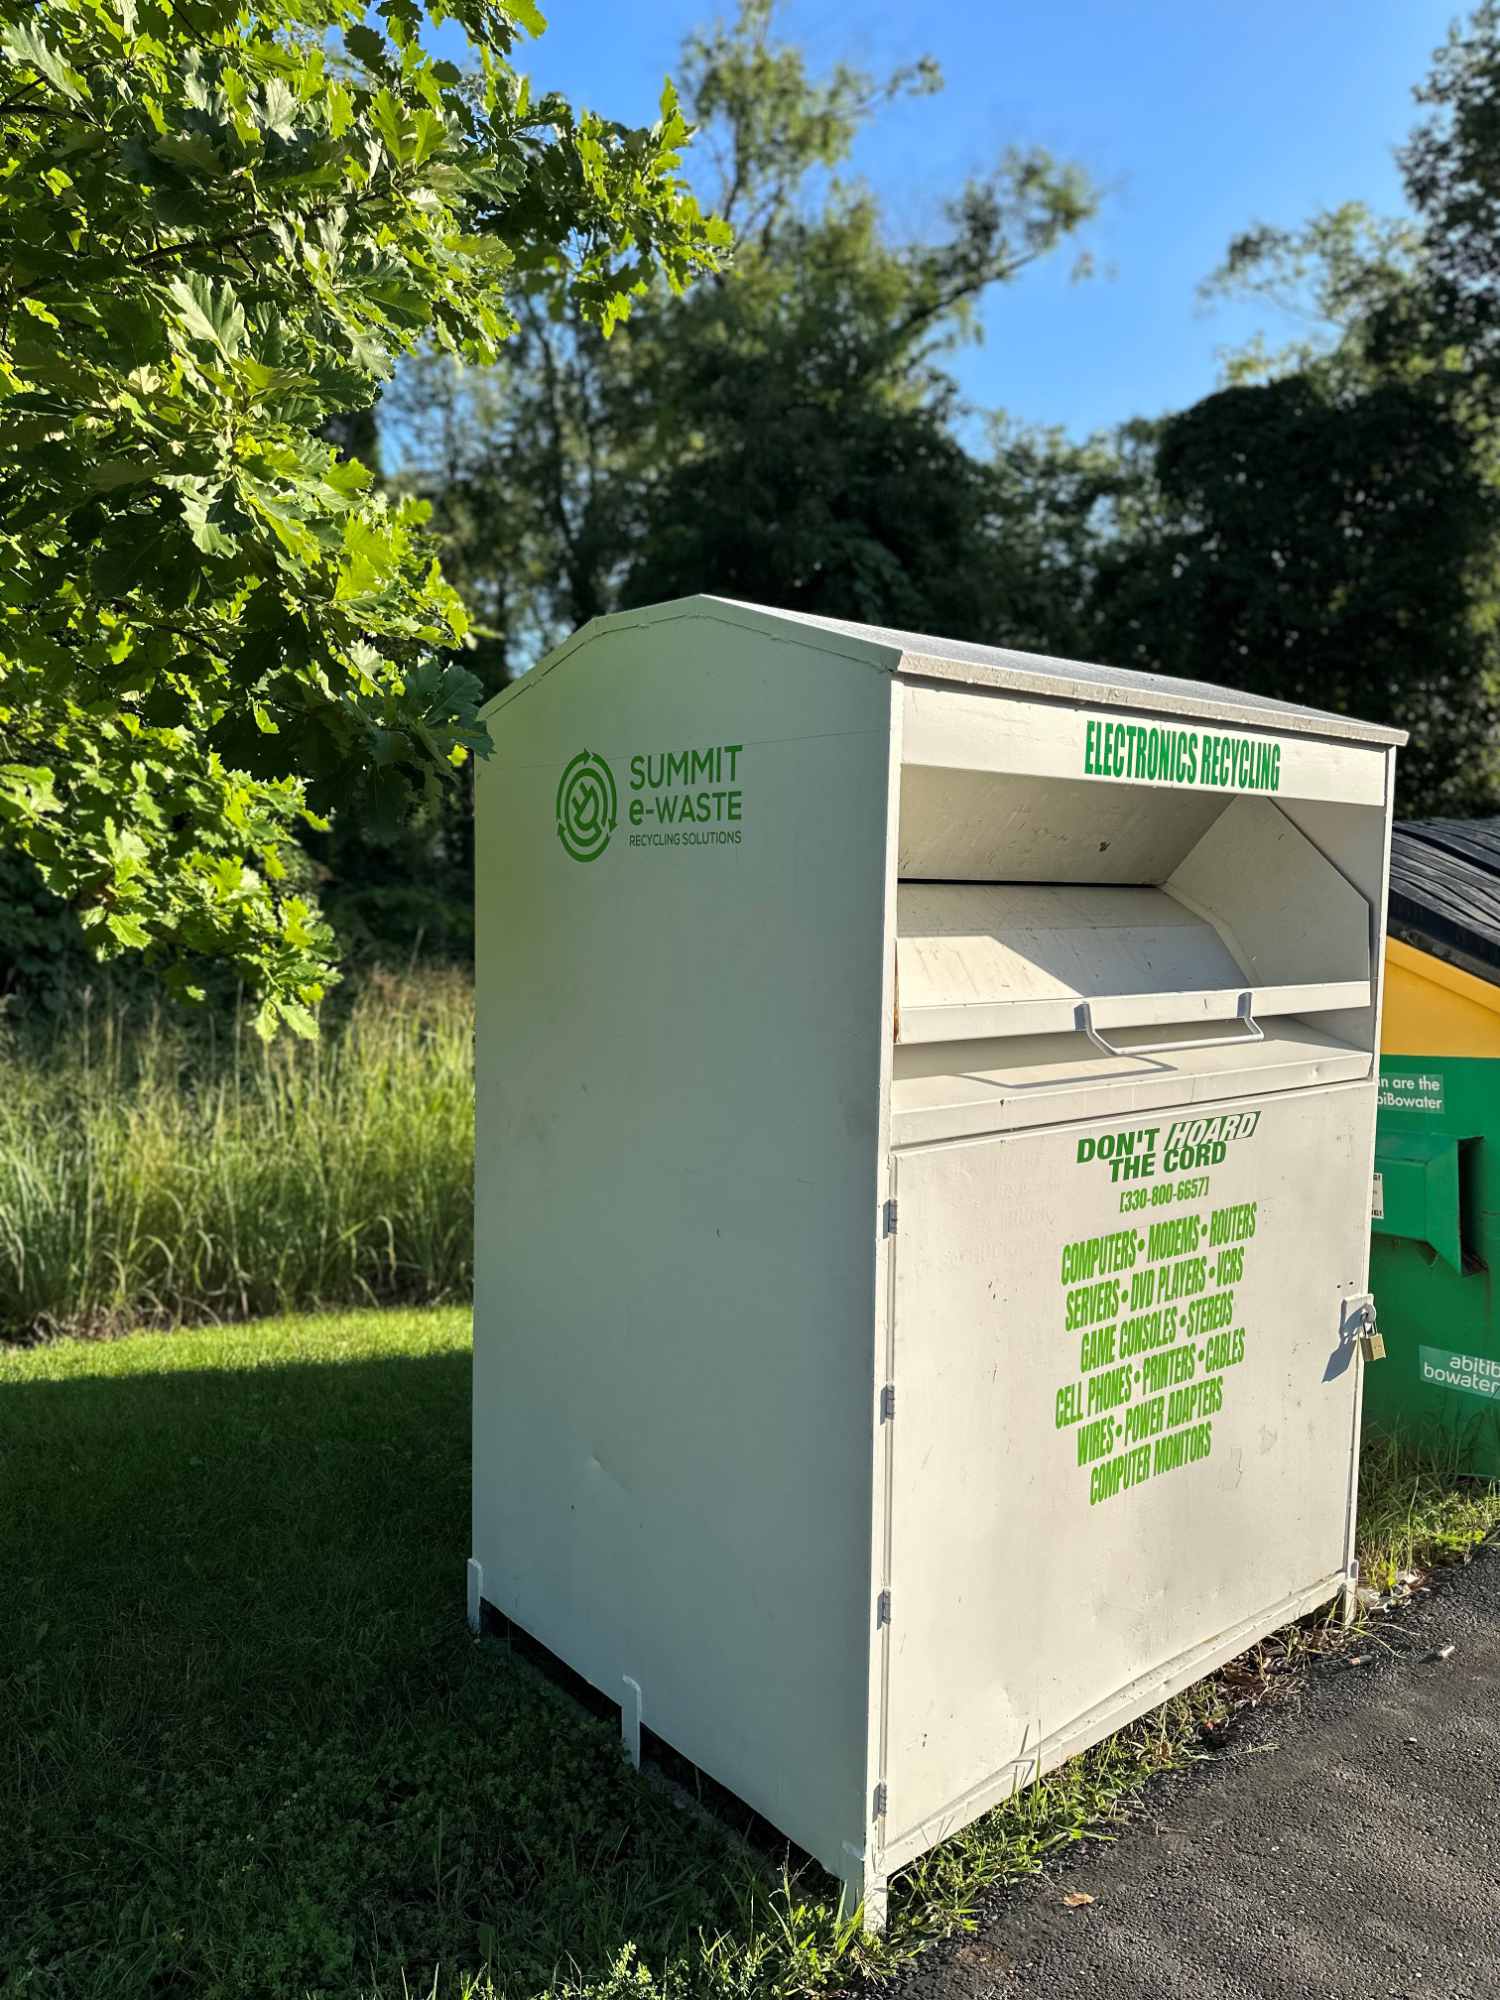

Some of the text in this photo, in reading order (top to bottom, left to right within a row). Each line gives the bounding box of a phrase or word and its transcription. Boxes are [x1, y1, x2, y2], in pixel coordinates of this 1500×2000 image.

[630, 745, 743, 790] SUMMIT
[1084, 720, 1281, 791] ELECTRONICS RECYCLING
[629, 791, 742, 825] e-WASTE
[629, 830, 742, 847] RECYCLING SOLUTIONS
[1392, 1079, 1415, 1089] are
[1419, 1074, 1440, 1091] the
[1077, 1111, 1261, 1163] DON'T HOARD
[1109, 1141, 1226, 1183] THE CORD
[1062, 1202, 1257, 1285] COMPUTERS MODEMS ROUTERS
[1065, 1246, 1244, 1331] SERVERS DVD PLAYERS VCRS
[1081, 1290, 1233, 1372] GAME CONSOLES STEREOS
[1056, 1327, 1245, 1429] CELL PHONES PRINTERS CABLES
[1424, 1361, 1500, 1393] bowater
[1077, 1376, 1223, 1467] WIRES POWER ADAPTERS
[1090, 1421, 1212, 1506] COMPUTER MONITORS
